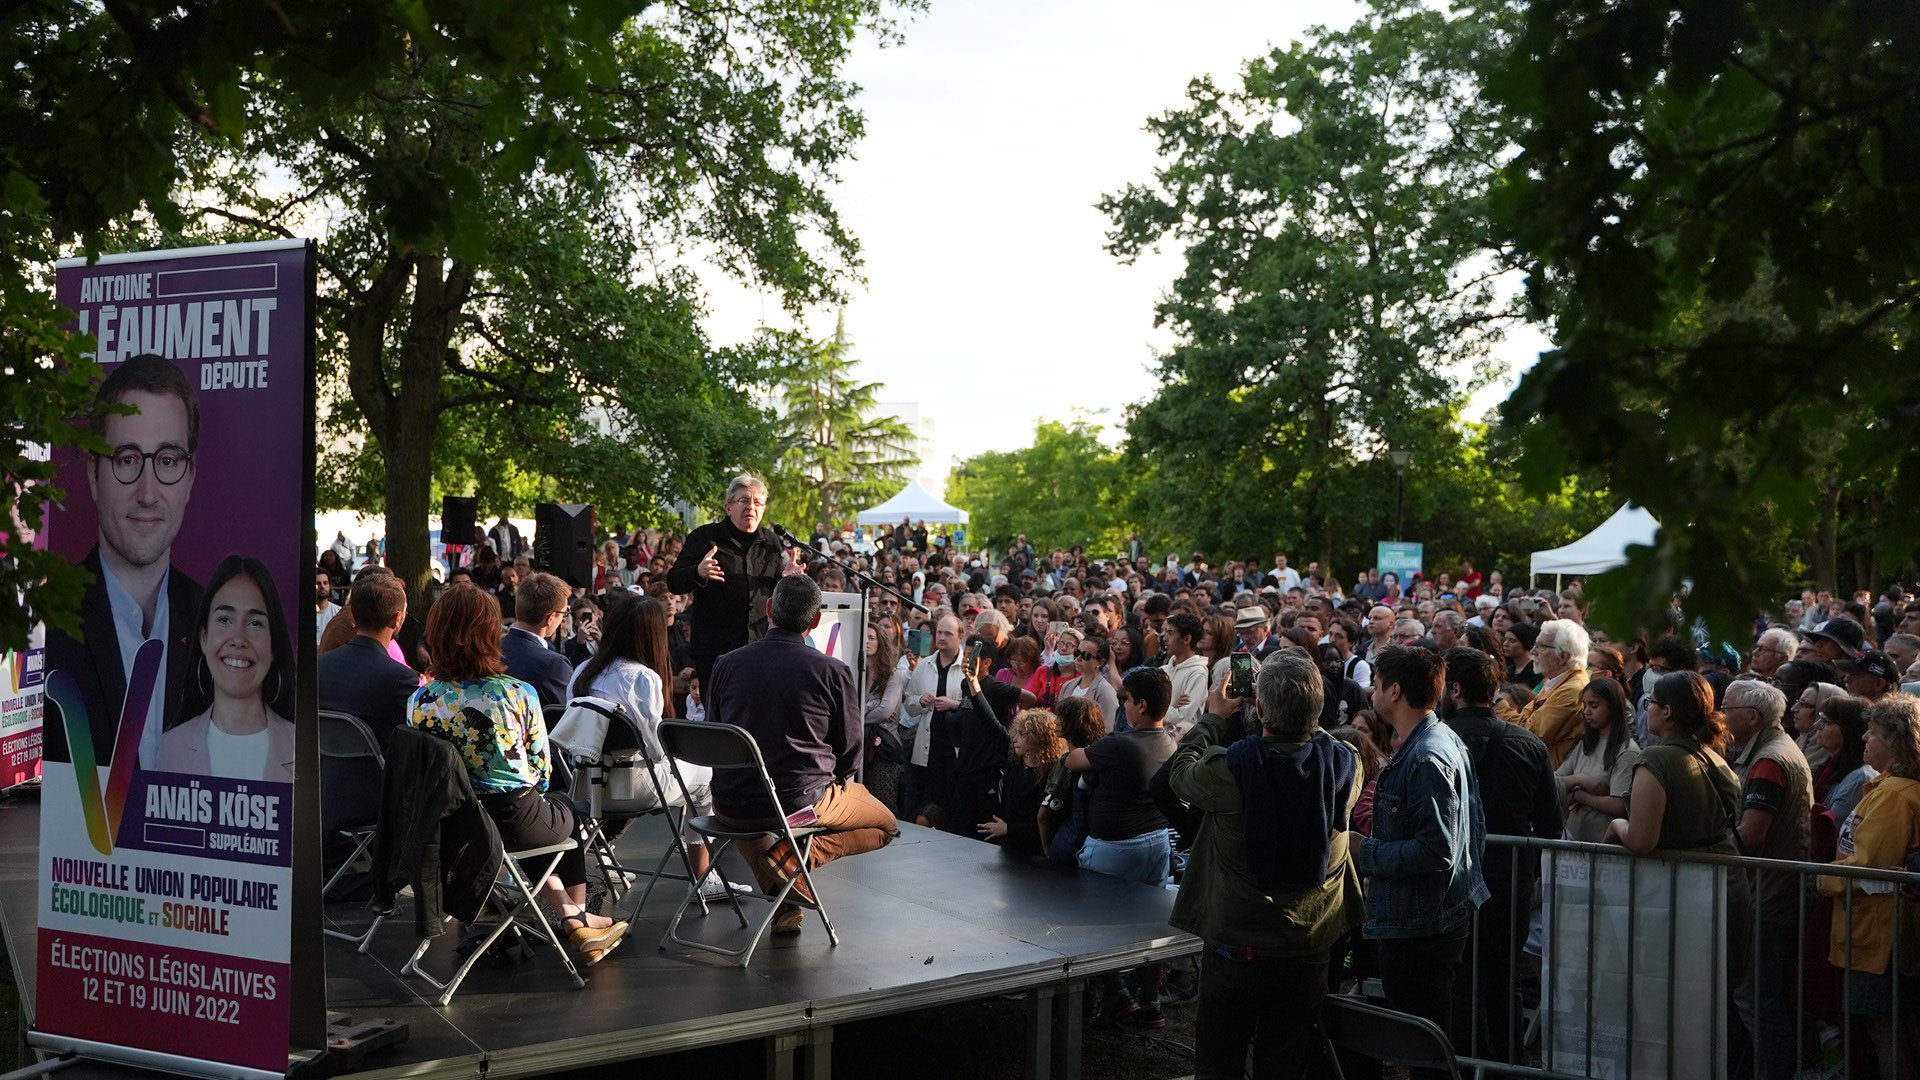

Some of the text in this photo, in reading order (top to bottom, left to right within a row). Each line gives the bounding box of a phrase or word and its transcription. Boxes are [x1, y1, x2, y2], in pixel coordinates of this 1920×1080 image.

[80, 273, 152, 303] ANTOINE
[79, 297, 277, 363] LÉAUMENT
[201, 360, 268, 390] DÉPUTÉ
[2, 697, 24, 714] NOUVELLE
[24, 694, 37, 708] UNION
[2, 709, 28, 729] ÉCOLOGIQUE
[2, 739, 28, 756] ÉLECTIONS
[11, 754, 17, 767] 12
[17, 751, 23, 765] ET
[23, 750, 29, 762] 19
[29, 746, 39, 761] JUIN
[145, 780, 280, 831] ANAÏS KÖSE
[210, 832, 279, 856] SUPPLÉANTE
[52, 857, 278, 911] NOUVELLE UNION POPULAIRE
[51, 883, 229, 936] ÉCOLOGIQUE ET SOCIALE
[51, 938, 277, 1000] ÉLECTIONS LÉGISLATIVES
[82, 976, 240, 1025] 12 ET 19 JUIN 2022
